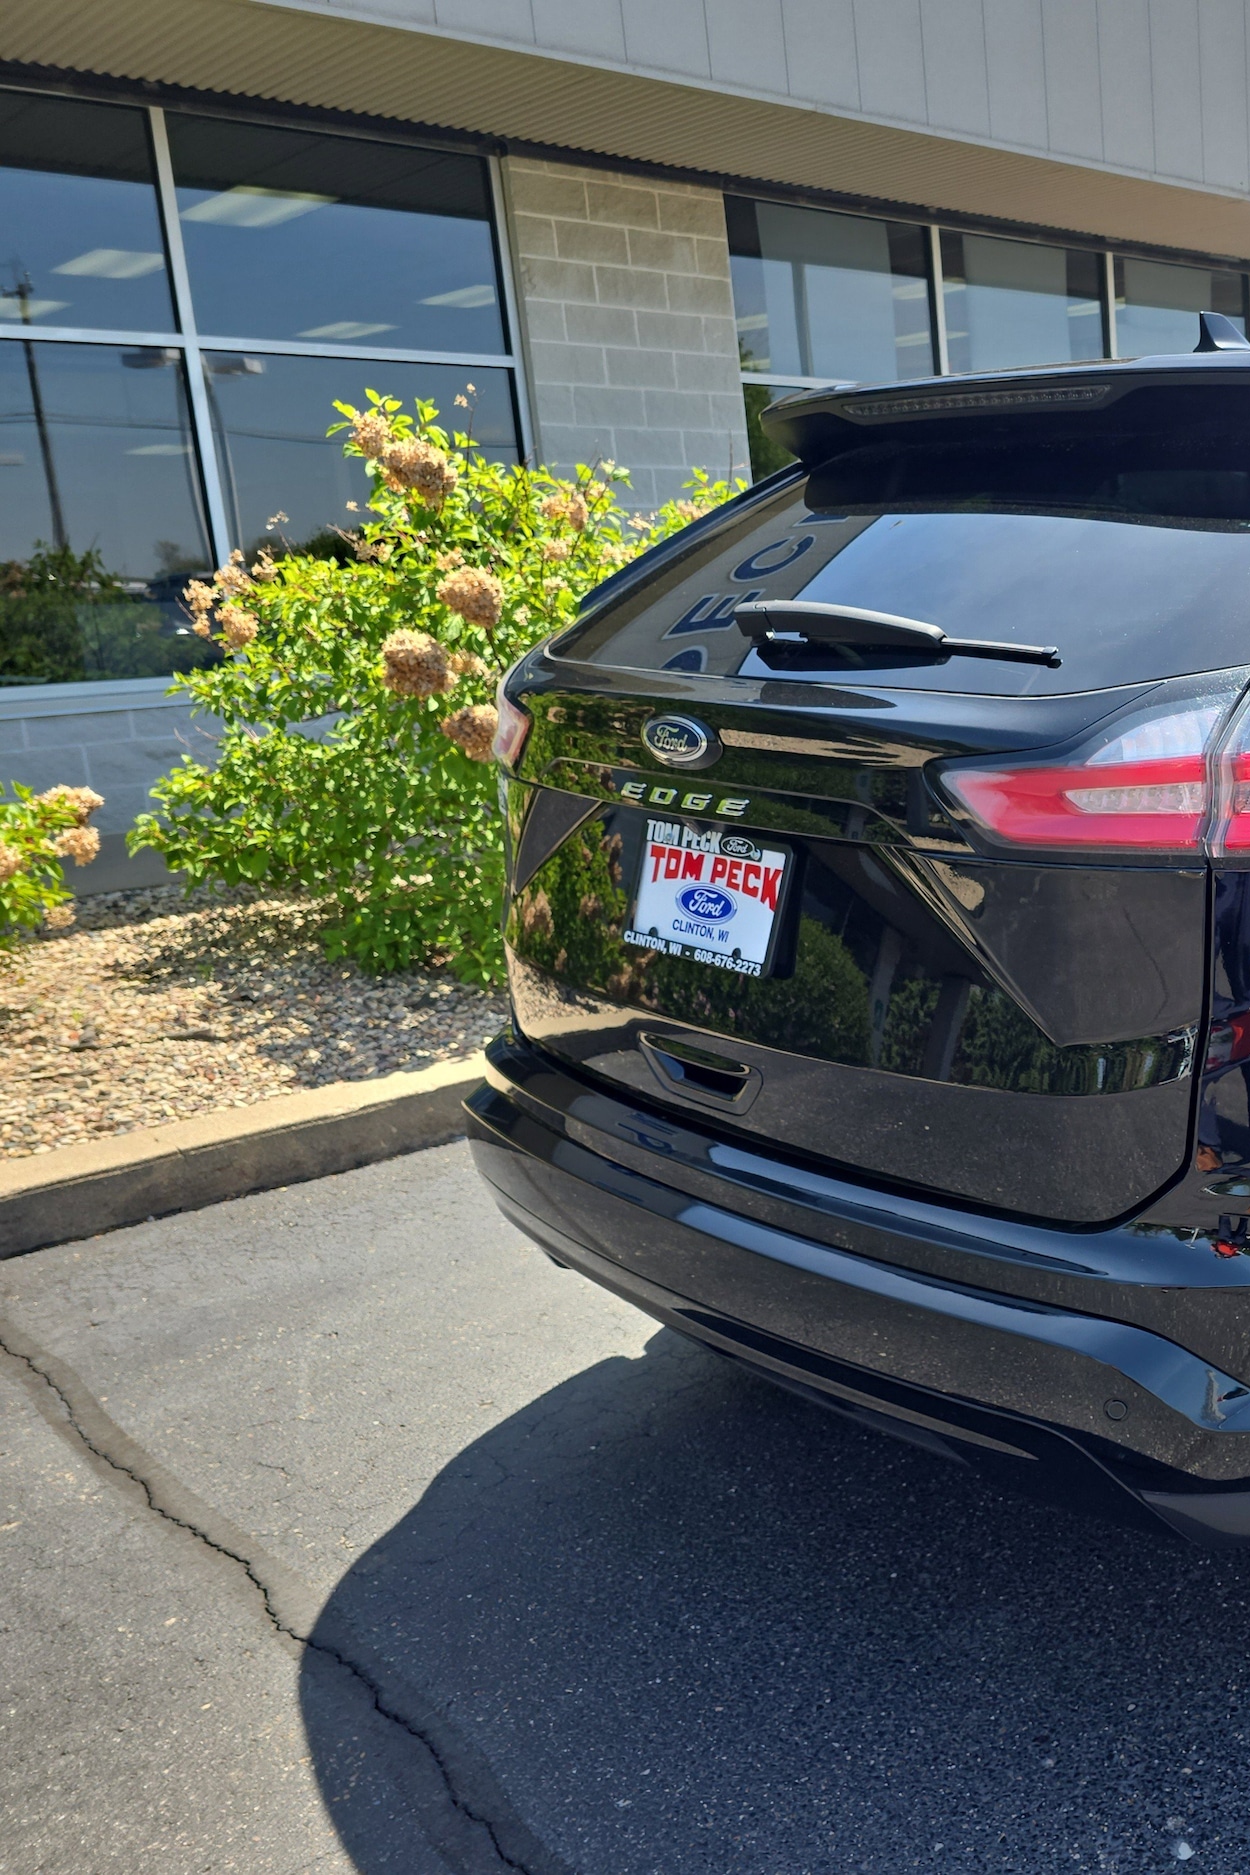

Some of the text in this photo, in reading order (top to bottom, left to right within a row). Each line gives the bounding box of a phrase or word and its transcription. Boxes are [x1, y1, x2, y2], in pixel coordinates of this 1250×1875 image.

[653, 725, 688, 752] Ford
[620, 781, 750, 817] EDGE
[646, 818, 749, 855] TOM PECK Ford
[650, 843, 784, 913] TOM PECK
[688, 889, 726, 917] Ford
[672, 918, 730, 944] CLINTON, WI
[623, 930, 668, 956] CLINTON,
[669, 941, 683, 957] WI
[693, 948, 762, 978] 608-676-2273
